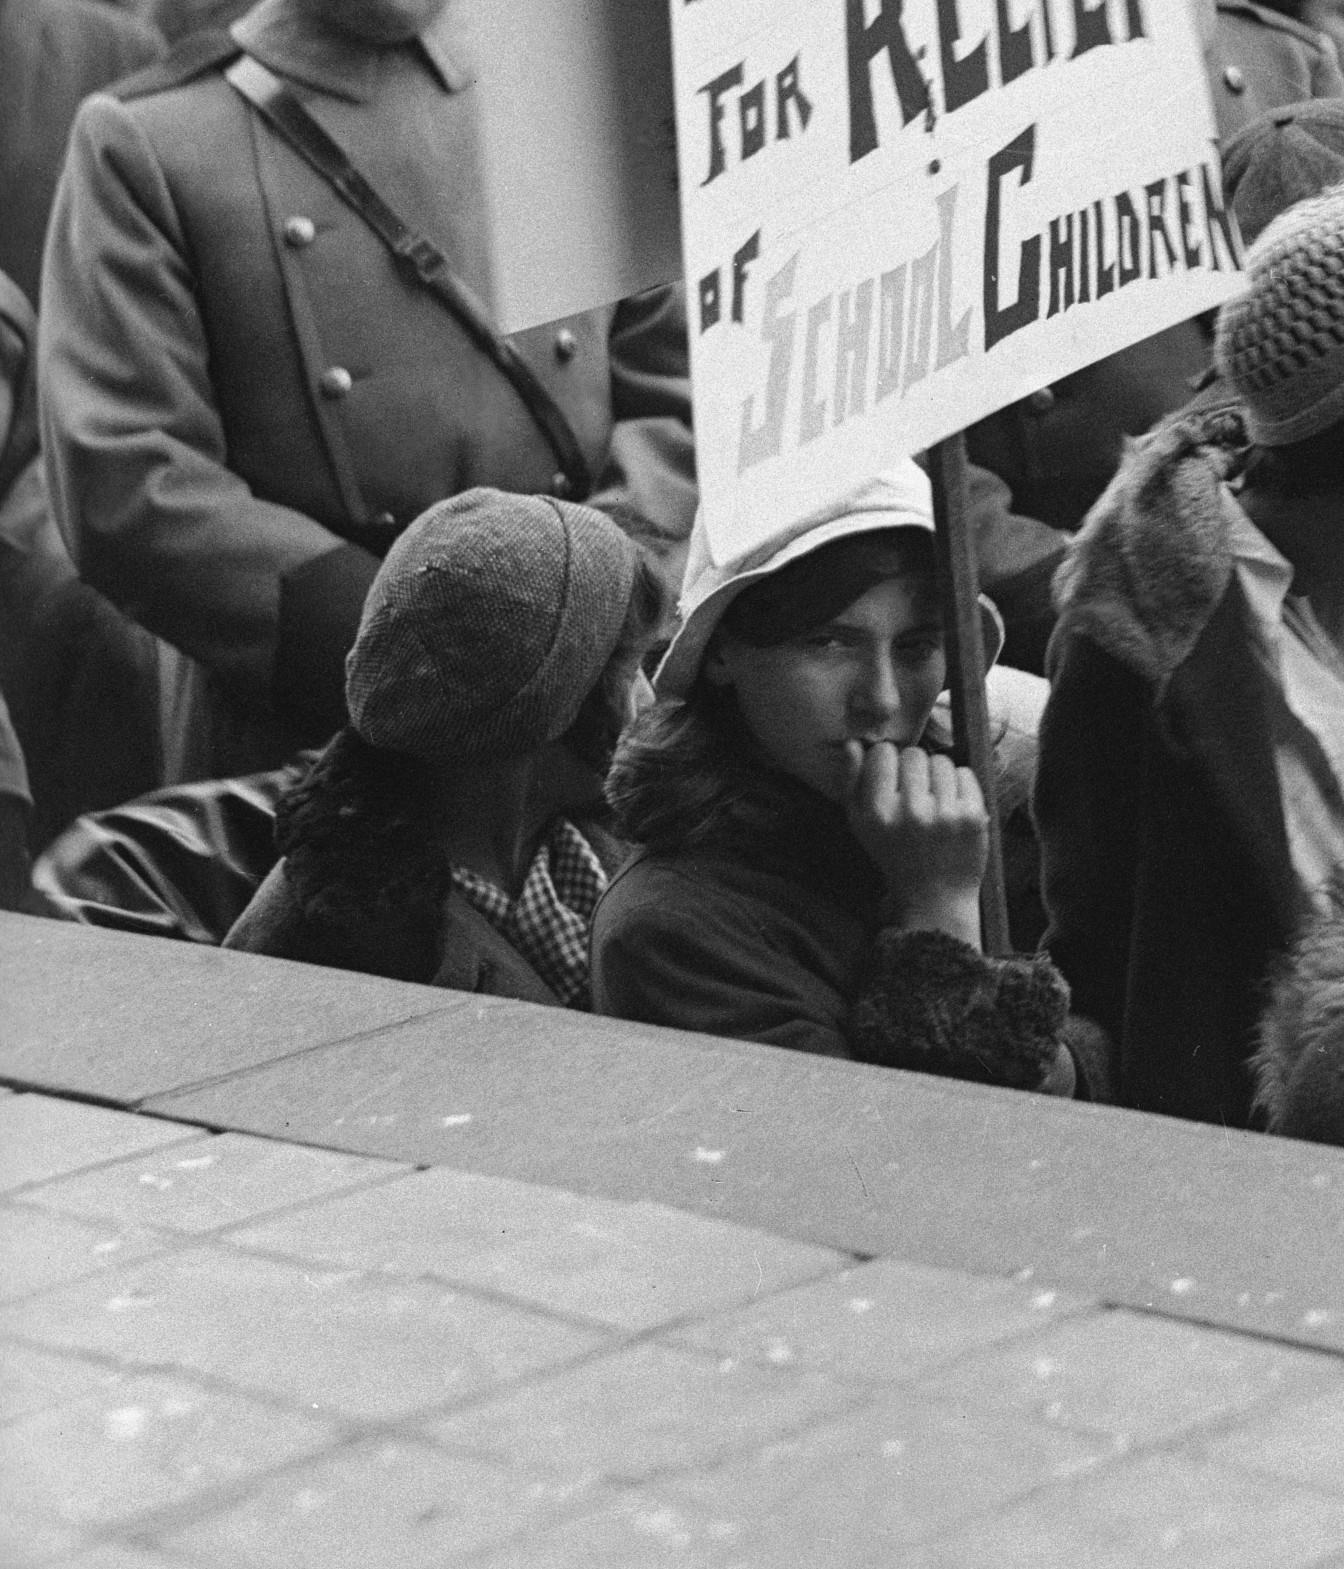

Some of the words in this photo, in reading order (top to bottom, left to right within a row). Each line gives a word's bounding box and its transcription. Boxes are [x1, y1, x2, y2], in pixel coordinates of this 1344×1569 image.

[696, 50, 814, 187] FOR
[738, 182, 974, 476] SCHOOL
[984, 122, 1247, 353] CHILDREN
